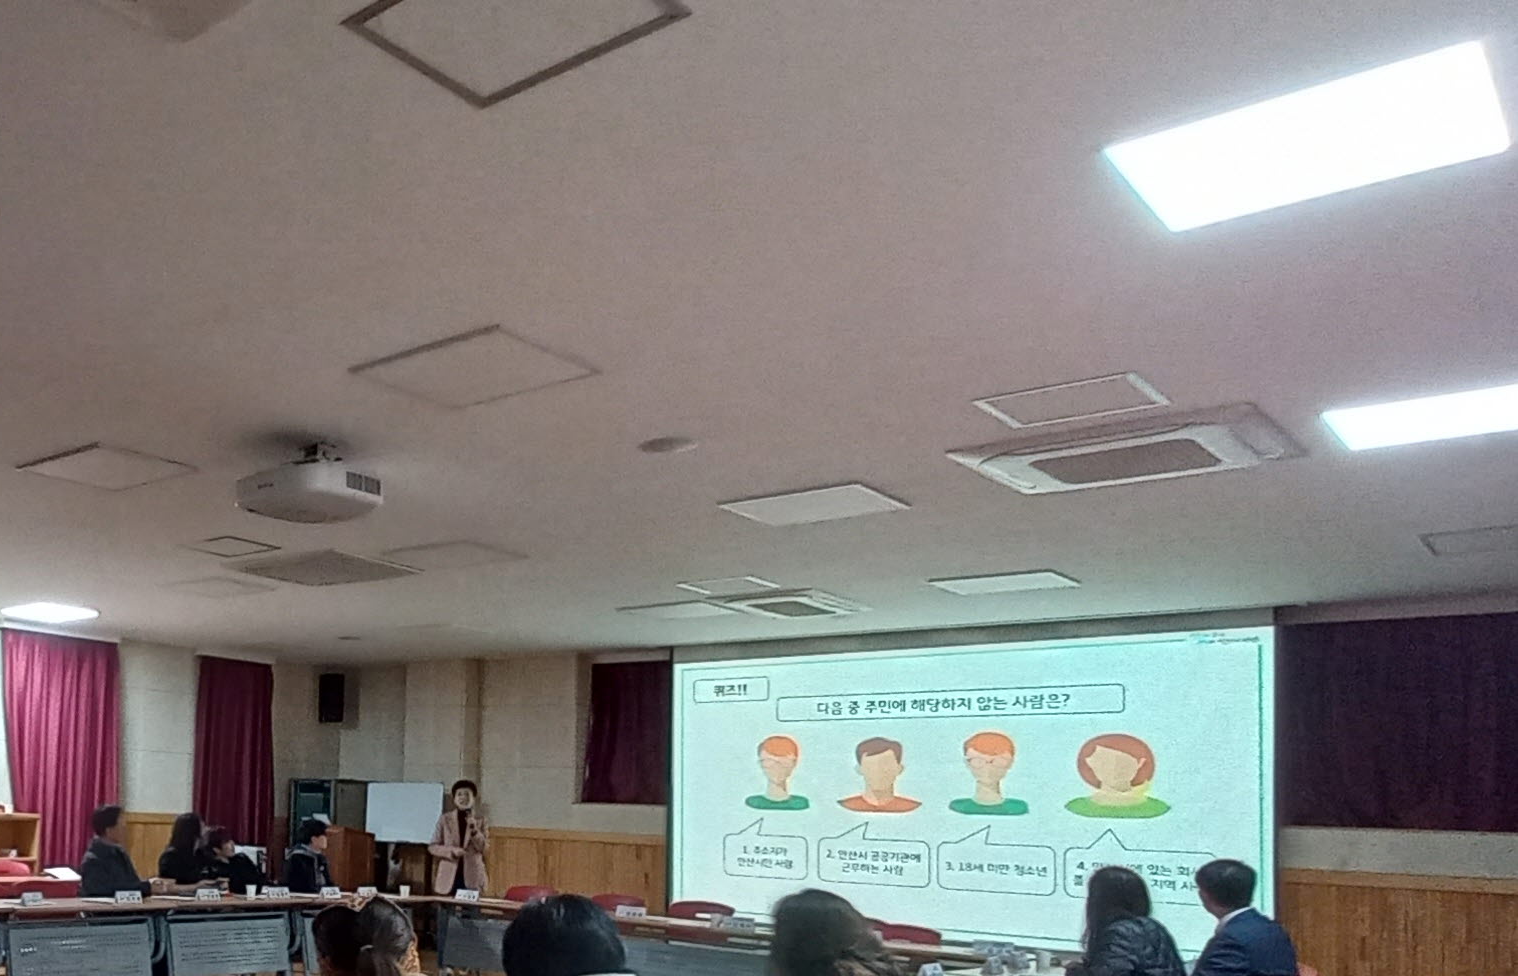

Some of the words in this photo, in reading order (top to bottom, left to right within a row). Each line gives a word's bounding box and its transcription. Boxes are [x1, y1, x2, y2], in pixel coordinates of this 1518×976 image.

[713, 684, 748, 697] 퀴즈!!
[816, 701, 843, 715] 다음
[848, 701, 860, 715] 중
[864, 699, 906, 714] 주민에
[910, 697, 971, 712] 해당하지
[976, 696, 1007, 711] 않는
[1012, 693, 1071, 710] 사람은?
[987, 863, 1010, 875] 미만
[1014, 864, 1048, 877] 청소년
[1147, 864, 1172, 877] 있는
